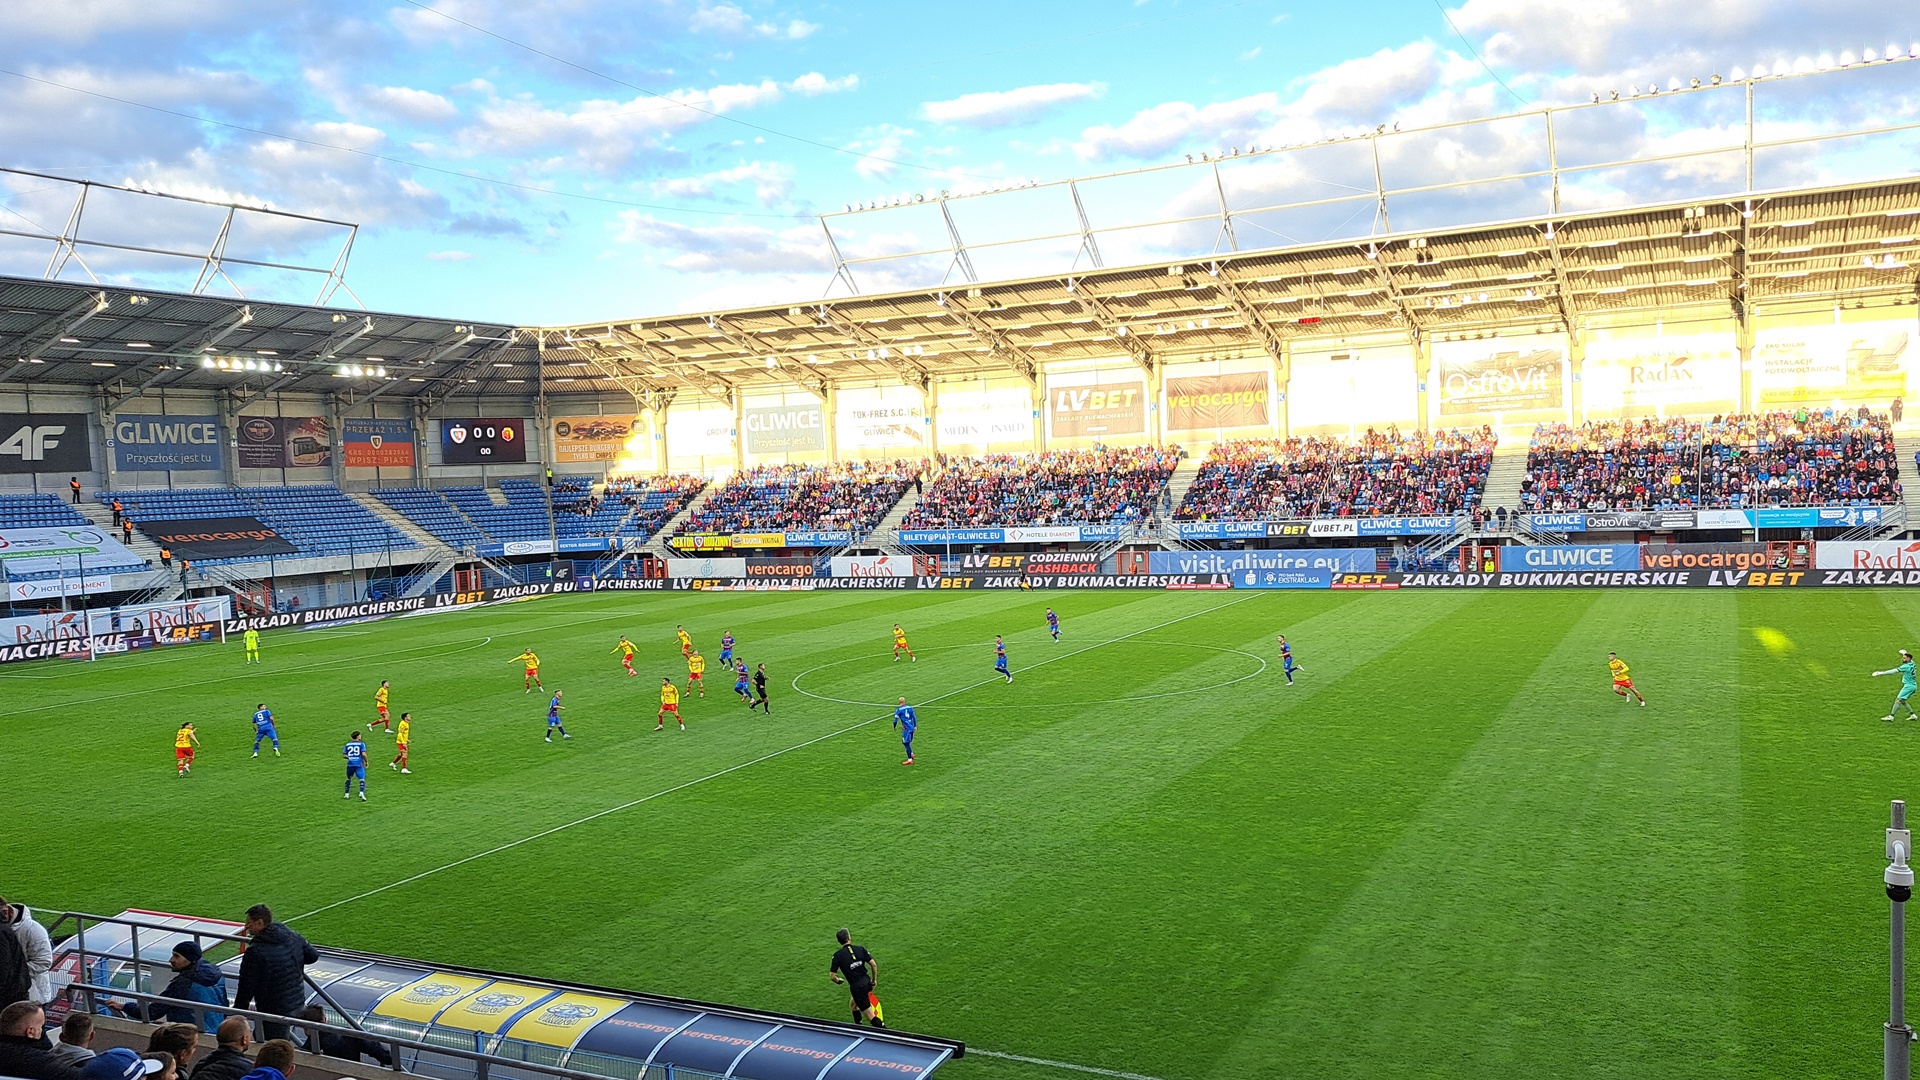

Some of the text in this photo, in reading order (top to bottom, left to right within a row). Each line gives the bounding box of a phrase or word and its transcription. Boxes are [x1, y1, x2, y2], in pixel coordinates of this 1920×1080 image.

[1765, 358, 1813, 366] INSTALACJE
[1765, 365, 1841, 374] FOTOWOLTAICZNE
[1445, 366, 1549, 396] OstroVit
[1056, 388, 1137, 412] LVBET
[1167, 389, 1267, 409] verocargo
[853, 409, 905, 418] TOK-FREZ S.C.
[747, 410, 819, 432] GLIWICE
[116, 422, 218, 445] GLIWICE
[346, 426, 386, 434] PRZEKAŻ
[473, 427, 495, 438] 0 0
[863, 427, 894, 436] GLIWICE
[0, 426, 66, 460] 4F
[558, 444, 589, 452] NAJLEPSZE
[589, 444, 615, 452] BURGERY
[754, 437, 815, 448] Przyszłość jest tu
[480, 447, 491, 455] 00
[126, 453, 211, 464] Przyszłość jest tu
[349, 456, 410, 464] WPISZ: PIAST
[1360, 519, 1403, 529] GLIWICE
[1408, 518, 1452, 528] GLIWICE
[1534, 515, 1581, 525] GLIWICE
[1586, 516, 1629, 528] OstroVit
[1081, 526, 1117, 535] GLIWICE
[1182, 524, 1219, 533] GLIWICE
[1224, 523, 1263, 532] GLIWICE
[1267, 525, 1307, 536] LVBET
[1312, 523, 1354, 533] LVBET.PL
[158, 529, 276, 543] verocargo
[786, 533, 815, 542] GLIWICE
[819, 532, 847, 541] GLIWICE
[903, 532, 1000, 542] BILETY@PIAST-GLIWICE.EU
[673, 536, 732, 548] SEKTOR RODZINNY
[963, 554, 1025, 568] LVBET
[1029, 552, 1098, 563] CODZIENNY
[1525, 549, 1614, 566] GLIWICE
[1644, 551, 1766, 570] verocargo
[556, 568, 568, 578] 4F
[747, 564, 812, 578] verocargo
[1027, 563, 1098, 574] CASHBACK
[672, 578, 721, 590] LVBET
[730, 578, 789, 587] ZAKŁADY
[791, 578, 907, 588] BUKMACHERSKIE
[916, 577, 975, 588] LVBET
[983, 577, 1054, 588] ZAKŁADY
[1057, 576, 1197, 588] BUKMACHERSKIE
[1278, 576, 1320, 584] EKSTRAKLASA
[1400, 573, 1495, 586] ZAKŁADY
[1499, 572, 1691, 586] BUKMACHERSKIE
[1707, 570, 1806, 586] LVBET
[1822, 571, 1920, 585] ZAKŁAD
[41, 585, 71, 593] HOTELE
[227, 612, 300, 633] ZAKŁADY
[304, 597, 426, 622] BUKMACHERSKIE
[436, 591, 484, 606] LVBET
[493, 583, 550, 599] ZAKŁADY
[257, 713, 264, 721] 9
[347, 746, 360, 756] 29
[344, 976, 399, 988] LVBET
[607, 1017, 675, 1033] verocargo
[682, 1029, 754, 1046] verocargo
[761, 1042, 836, 1060] verocargo
[845, 1055, 924, 1073] verocargo
